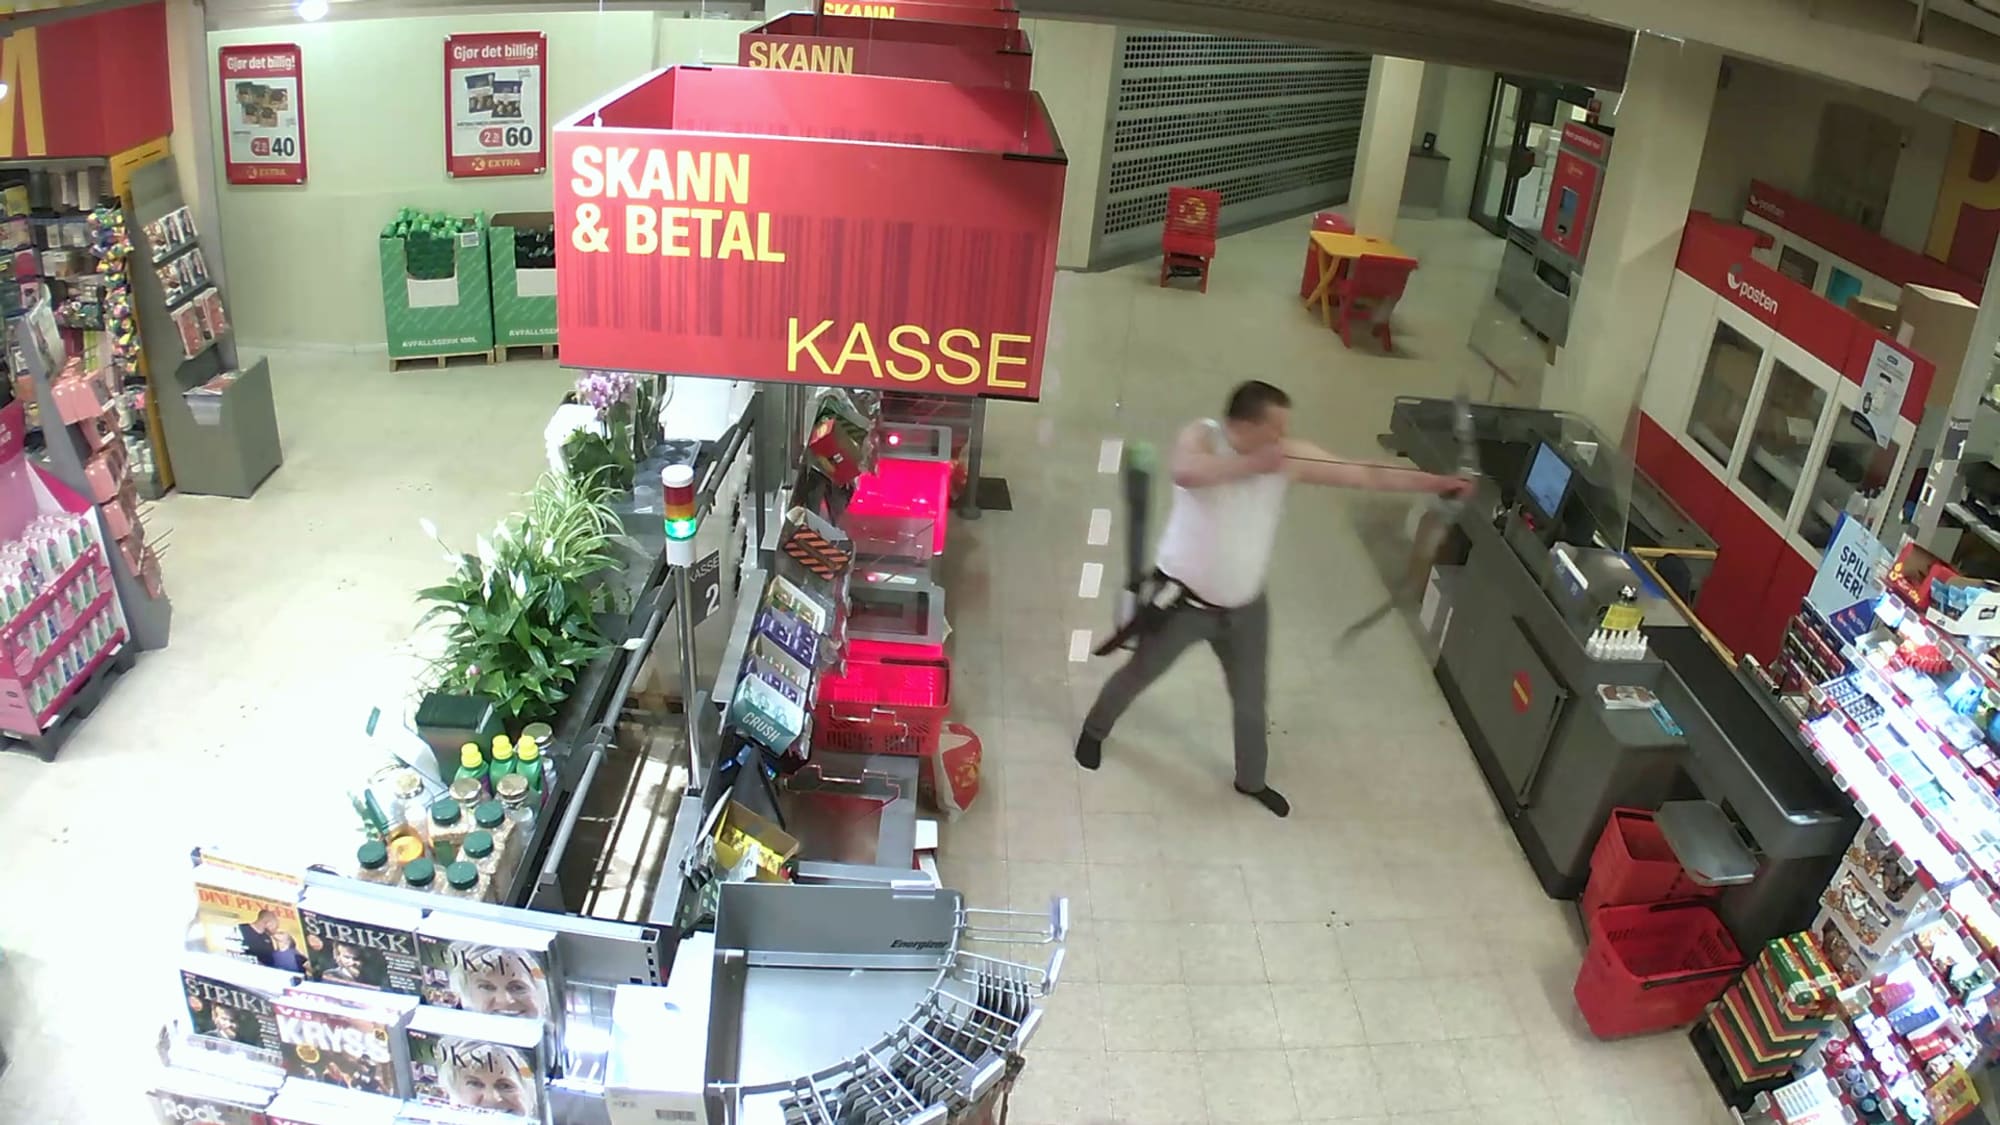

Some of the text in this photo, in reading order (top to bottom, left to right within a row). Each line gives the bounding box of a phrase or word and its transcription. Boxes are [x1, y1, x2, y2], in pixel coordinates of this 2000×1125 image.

[227, 55, 296, 72] Gjør det billig!
[453, 43, 538, 61] Gjør det billig!
[749, 41, 854, 75] SKANN
[272, 137, 295, 156] 40
[506, 126, 533, 147] 60
[488, 158, 520, 168] EXTRA
[571, 145, 750, 205] SKANN
[571, 202, 786, 263] & BETAL
[1739, 282, 1778, 315] posten
[787, 316, 1032, 390] KASSE
[1840, 545, 1870, 585] SPILL
[1835, 565, 1864, 600] HER!
[705, 583, 720, 617] 2
[742, 711, 781, 743] CRUSH
[304, 915, 410, 955] STRIKK
[890, 939, 949, 951] Energizer
[276, 1014, 391, 1064] KRYSS
